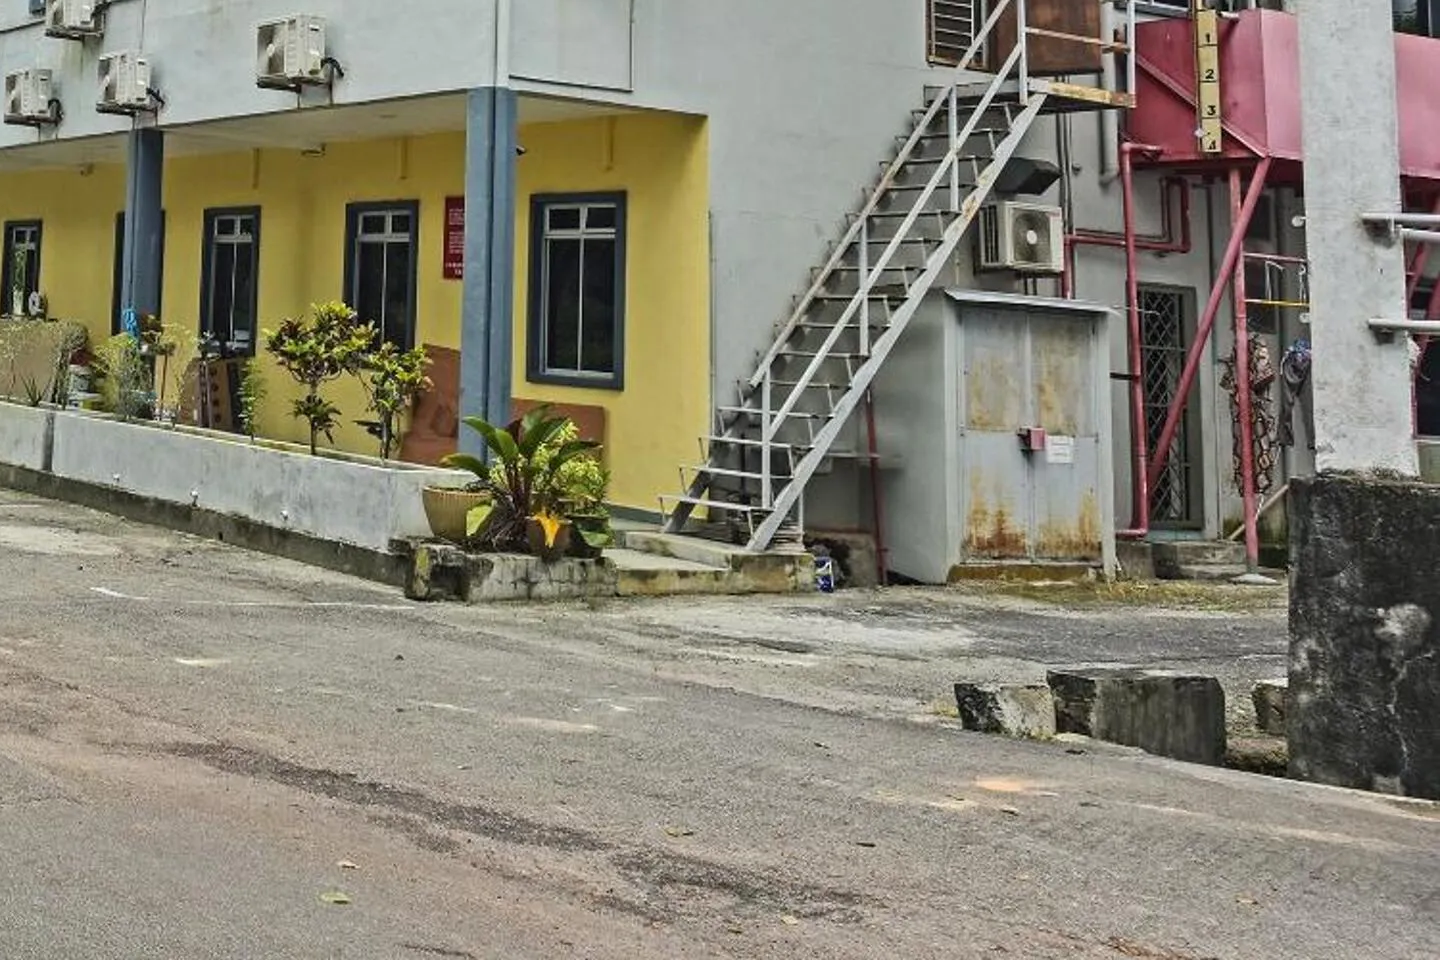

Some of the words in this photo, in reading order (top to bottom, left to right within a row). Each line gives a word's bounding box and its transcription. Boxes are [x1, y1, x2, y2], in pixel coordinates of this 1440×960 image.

[1205, 33, 1211, 43] 1
[1205, 69, 1215, 79] 2
[1207, 105, 1216, 116] 3
